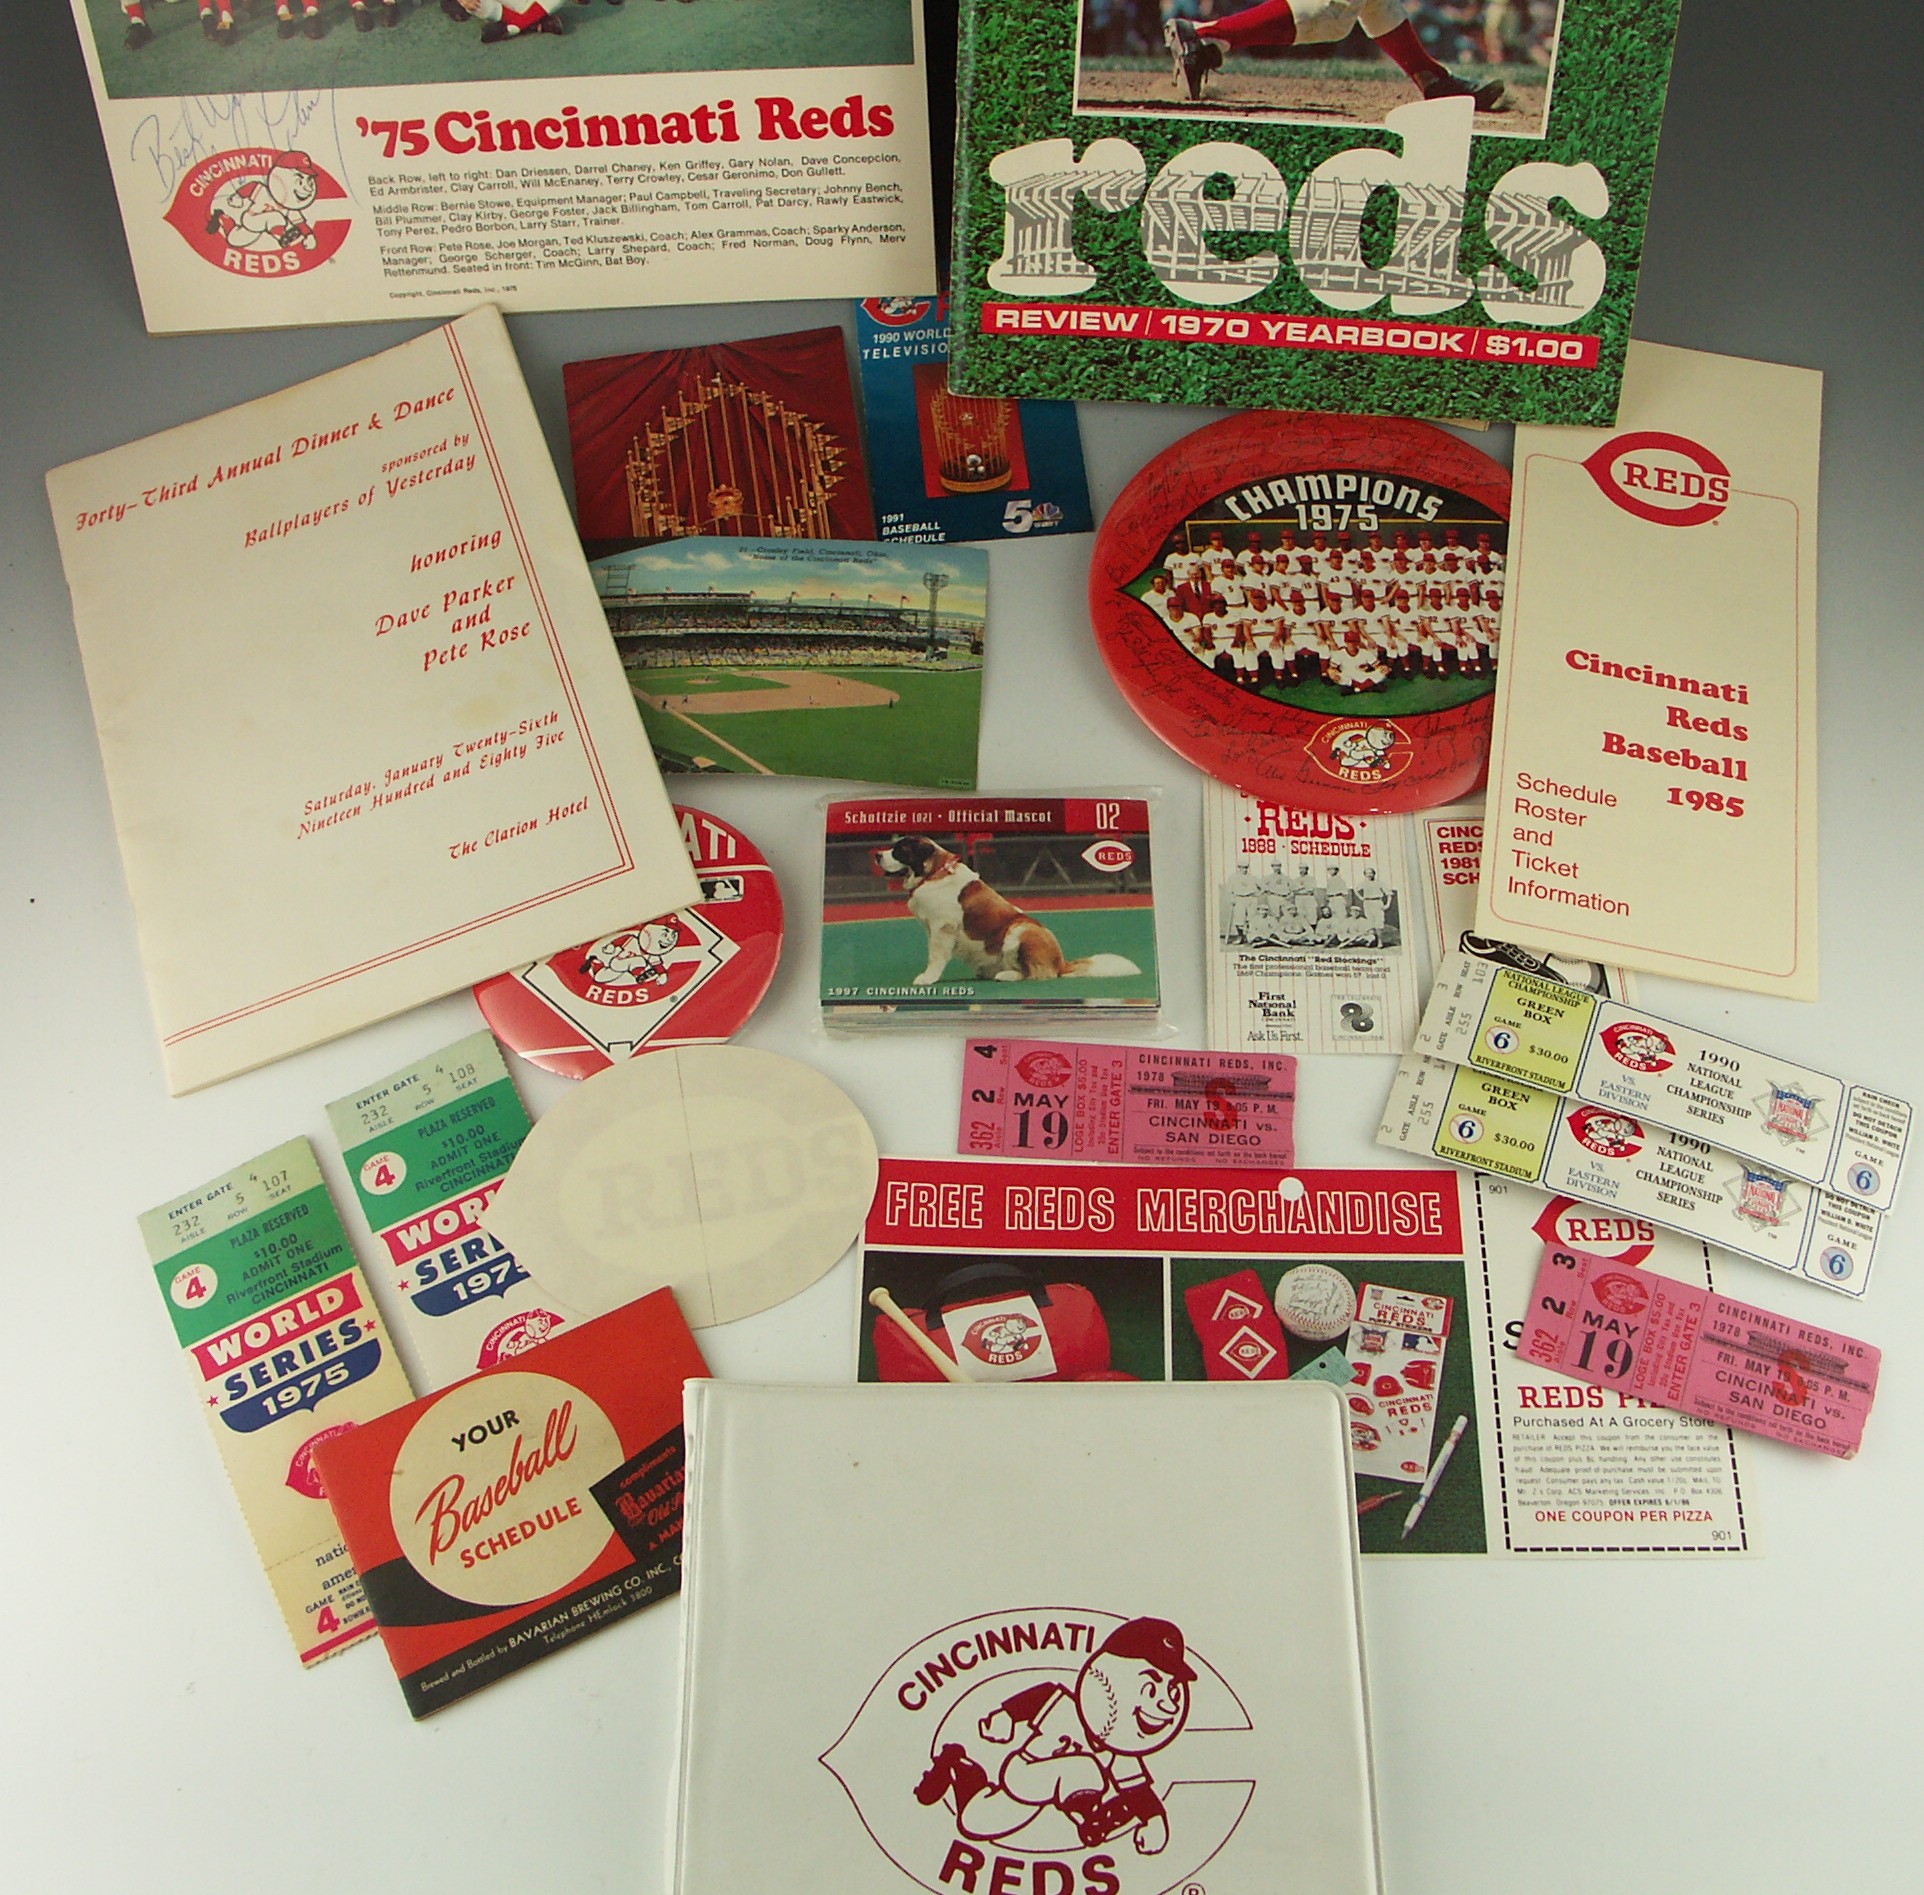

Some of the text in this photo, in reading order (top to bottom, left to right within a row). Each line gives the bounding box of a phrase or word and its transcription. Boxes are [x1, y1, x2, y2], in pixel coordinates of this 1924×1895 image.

[355, 95, 895, 159] '75 Cincinnati Reds
[189, 154, 273, 198] CINCINNATI
[988, 95, 1609, 327] reds
[377, 228, 402, 238] Tony
[405, 226, 438, 235] Perez,
[441, 224, 472, 233] Pedro
[475, 223, 517, 231] Borbon,
[519, 221, 547, 230] Larry
[550, 219, 579, 228] Starr,
[223, 248, 301, 274] REDS
[873, 333, 901, 344] 1990
[996, 310, 1582, 359] REVIEW 1970 YEARBOOK $1.00
[863, 343, 951, 360] TELEVISIO
[207, 446, 281, 488] Annual
[291, 422, 358, 457] Dinner
[368, 413, 382, 430] &
[394, 388, 454, 421] Dance
[382, 434, 469, 472] sponsored by
[1622, 462, 1729, 504] REDS
[245, 454, 475, 547] Ballplayers of Yesterday
[1225, 474, 1445, 523] CHAMPIONS
[882, 513, 904, 524] 1991
[883, 522, 941, 536] BASEBALL
[1002, 499, 1034, 534] 5
[1298, 504, 1379, 532] 1975
[411, 530, 501, 571] honoring
[375, 576, 514, 636] Dave Parker
[452, 606, 490, 633] and
[424, 622, 529, 671] Pete Rose
[1566, 648, 1749, 705] Cincinnati
[1667, 705, 1749, 742] Reds
[385, 755, 443, 787] January
[453, 710, 557, 757] Twenty-Sixth
[1603, 731, 1748, 781] Baseball
[1339, 766, 1382, 781] REDS
[297, 806, 360, 840] Nineteen
[373, 774, 433, 808] Hundred
[443, 761, 469, 782] and
[479, 744, 526, 769] Eighty
[1517, 772, 1617, 808] Schedule
[1667, 785, 1744, 818] 1985
[845, 811, 906, 823] Schottzie
[949, 810, 999, 822] Official
[1005, 810, 1052, 823] Mascot
[1096, 803, 1119, 830] 02
[1258, 801, 1357, 840] REDS
[1515, 798, 1587, 827] Roster
[449, 796, 587, 858] The Clarion Hotel
[1513, 824, 1553, 847] and
[1098, 850, 1132, 864] REDS
[1242, 838, 1371, 858] 1988 SCHEDULE
[1441, 858, 1480, 869] 1981
[1511, 849, 1579, 879] Ticket
[1508, 875, 1631, 917] Information
[828, 987, 975, 996] 1997 CINCINNATI REDS
[1259, 993, 1285, 1001] First
[1504, 970, 1590, 1003] NATIONAL LEAGUE
[1508, 980, 1581, 1008] CHAMPIONSHIP
[1248, 1001, 1297, 1009] National
[1262, 1009, 1294, 1018] Bank
[1517, 997, 1566, 1018] GREEN
[1523, 1010, 1553, 1025] BOX
[1494, 1016, 1522, 1029] GAME
[1494, 1032, 1511, 1050] 6
[1529, 1045, 1569, 1064] $30.00
[1139, 1054, 1287, 1071] CINCINNATI REDS, INC.
[1475, 1055, 1567, 1090] RIVERFRONT STADIUM
[1613, 1052, 1647, 1071] REDS
[1699, 1050, 1740, 1072] 1990
[1137, 1071, 1165, 1082] 1978
[1687, 1063, 1744, 1089] NATIONAL
[1690, 1078, 1735, 1100] LEAGUE
[1014, 1093, 1070, 1109] MAY
[1599, 1089, 1649, 1111] DIVISION
[1600, 1080, 1652, 1102] EASTERN
[1666, 1084, 1752, 1119] CHAMPIONSHIP
[1150, 1116, 1247, 1128] CINCINNATI
[1686, 1106, 1725, 1125] SERIES
[970, 1121, 995, 1151] 362
[1012, 1110, 1069, 1150] 19
[1166, 1132, 1261, 1146] SAN DIEGO
[1855, 1151, 1885, 1168] GAME
[374, 1165, 396, 1188] 4
[1856, 1171, 1872, 1190] 6
[168, 1181, 234, 1220] ENTER GATE
[885, 1181, 1444, 1237] FREE REDS MERCHANDISE
[254, 1233, 297, 1257] $10.00
[1566, 1219, 1655, 1243] REDS
[227, 1243, 343, 1304] Riverfront Stadium
[242, 1240, 314, 1283] ADMIT ONE
[186, 1276, 207, 1300] 4
[251, 1263, 329, 1304] CINCINNATI
[1583, 1310, 1639, 1339] MAY
[225, 1319, 362, 1401] SERIES
[1572, 1330, 1634, 1379] 19
[262, 1361, 350, 1416] 1975
[1518, 1386, 1604, 1409] REDS
[452, 1409, 520, 1453] YOUR
[1514, 1416, 1715, 1429] Purchased At A Grocery Store
[415, 1400, 577, 1566] Baseball
[1536, 1511, 1713, 1522] ONE COUPON PER PIZZA
[461, 1497, 582, 1569] SCHEDULE
[506, 1611, 568, 1647] BAVARIAN
[571, 1585, 622, 1616] BREWING
[898, 1624, 1096, 1713] CINCINNATI
[939, 1840, 1120, 1895] REDS
